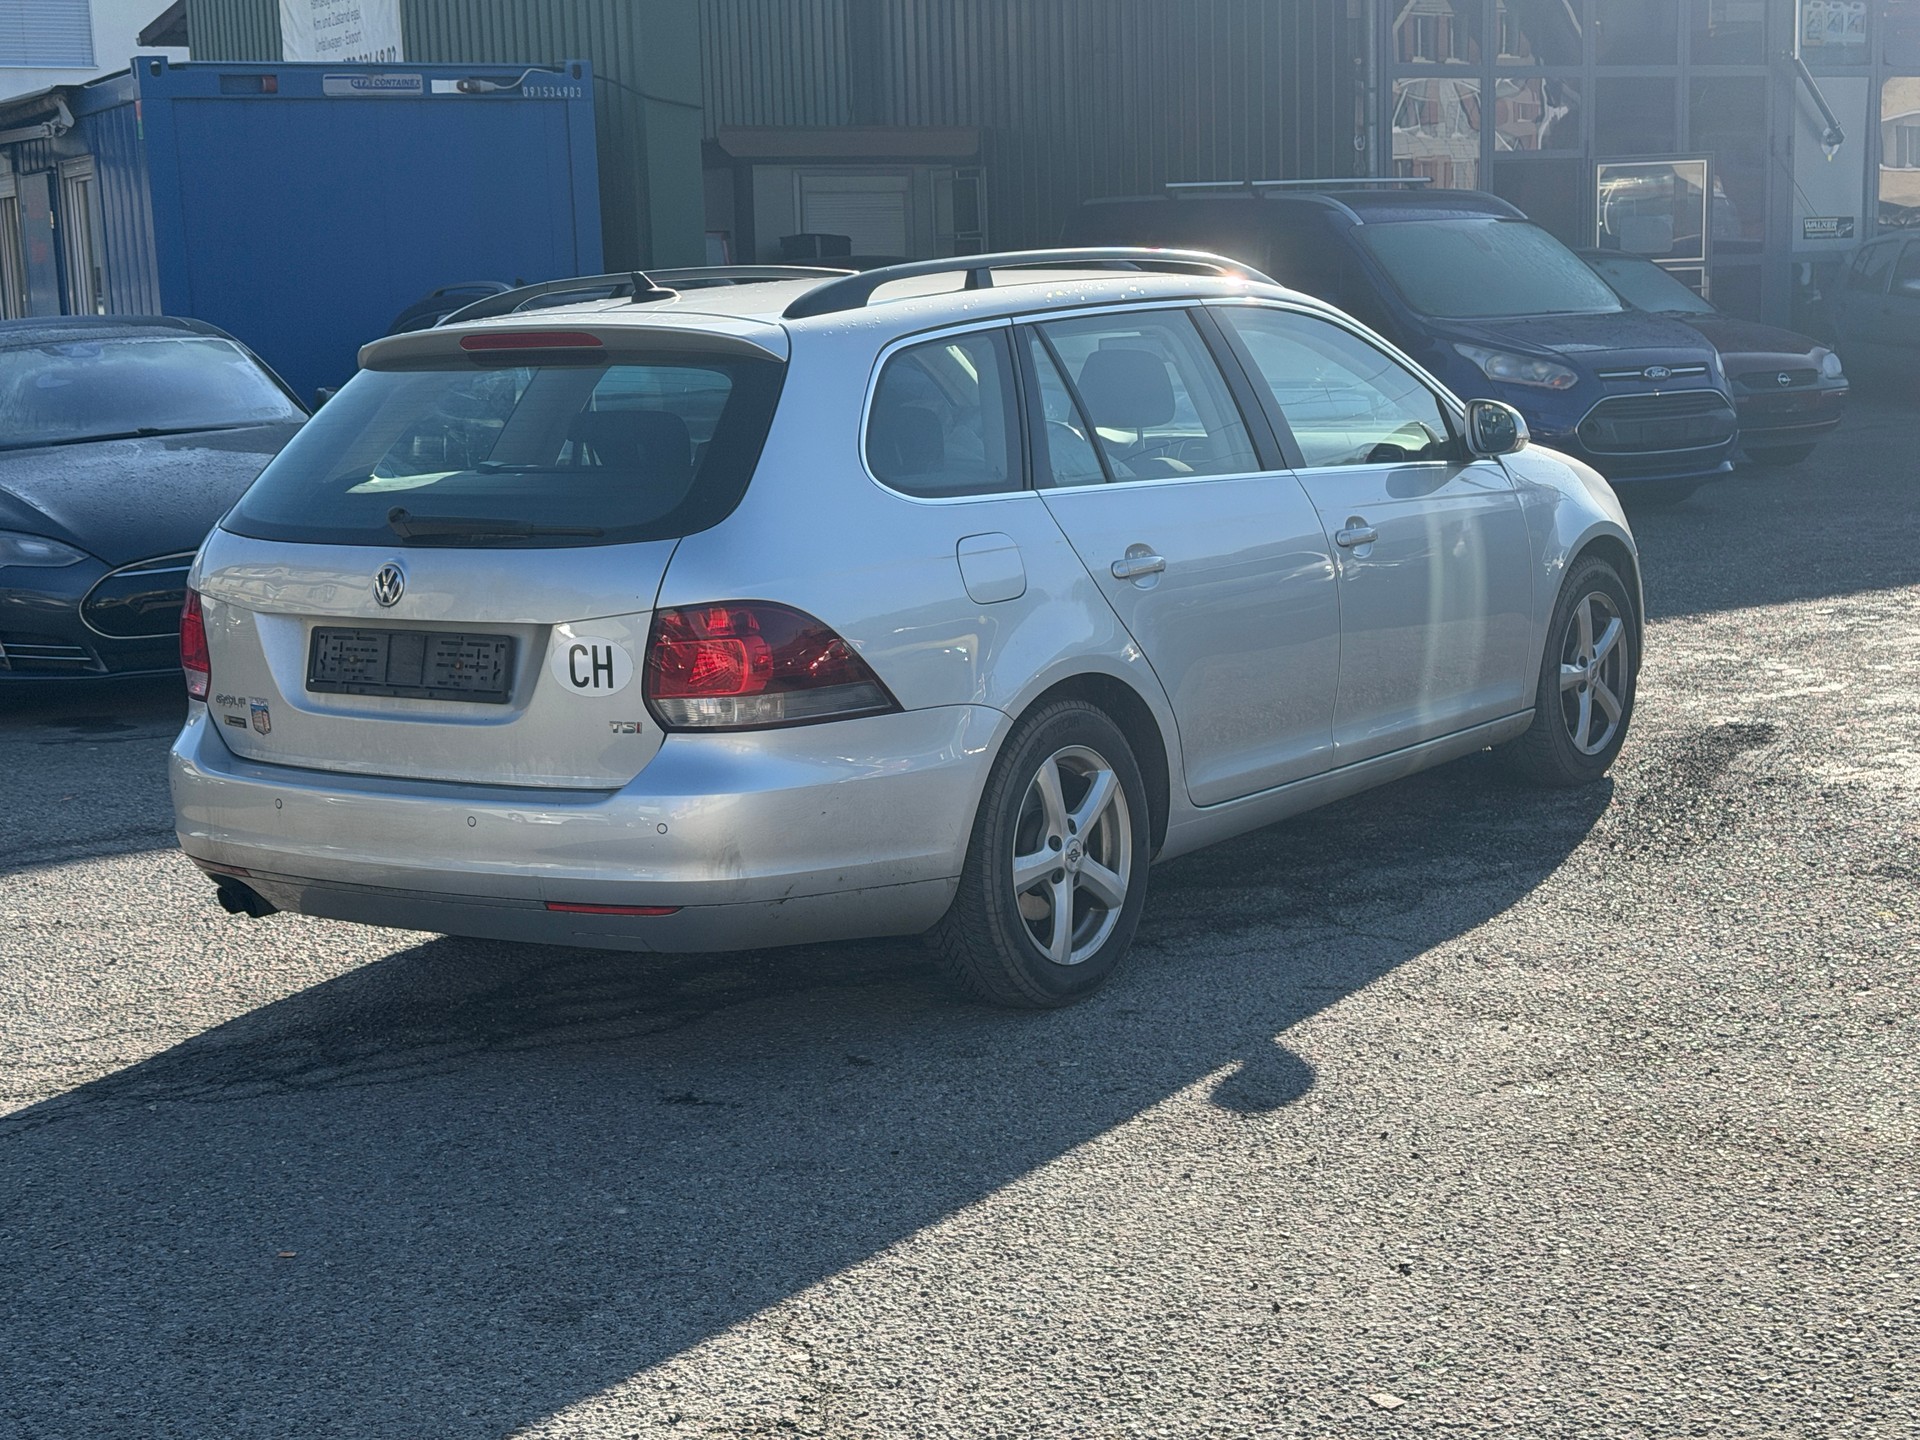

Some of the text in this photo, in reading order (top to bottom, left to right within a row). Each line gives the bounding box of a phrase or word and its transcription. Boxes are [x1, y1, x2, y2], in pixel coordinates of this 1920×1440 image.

[374, 78, 420, 88] CONTAINEX
[523, 86, 581, 98] 091534903
[1804, 219, 1838, 231] WALKER
[569, 643, 614, 688] CH
[608, 720, 643, 734] TSI
